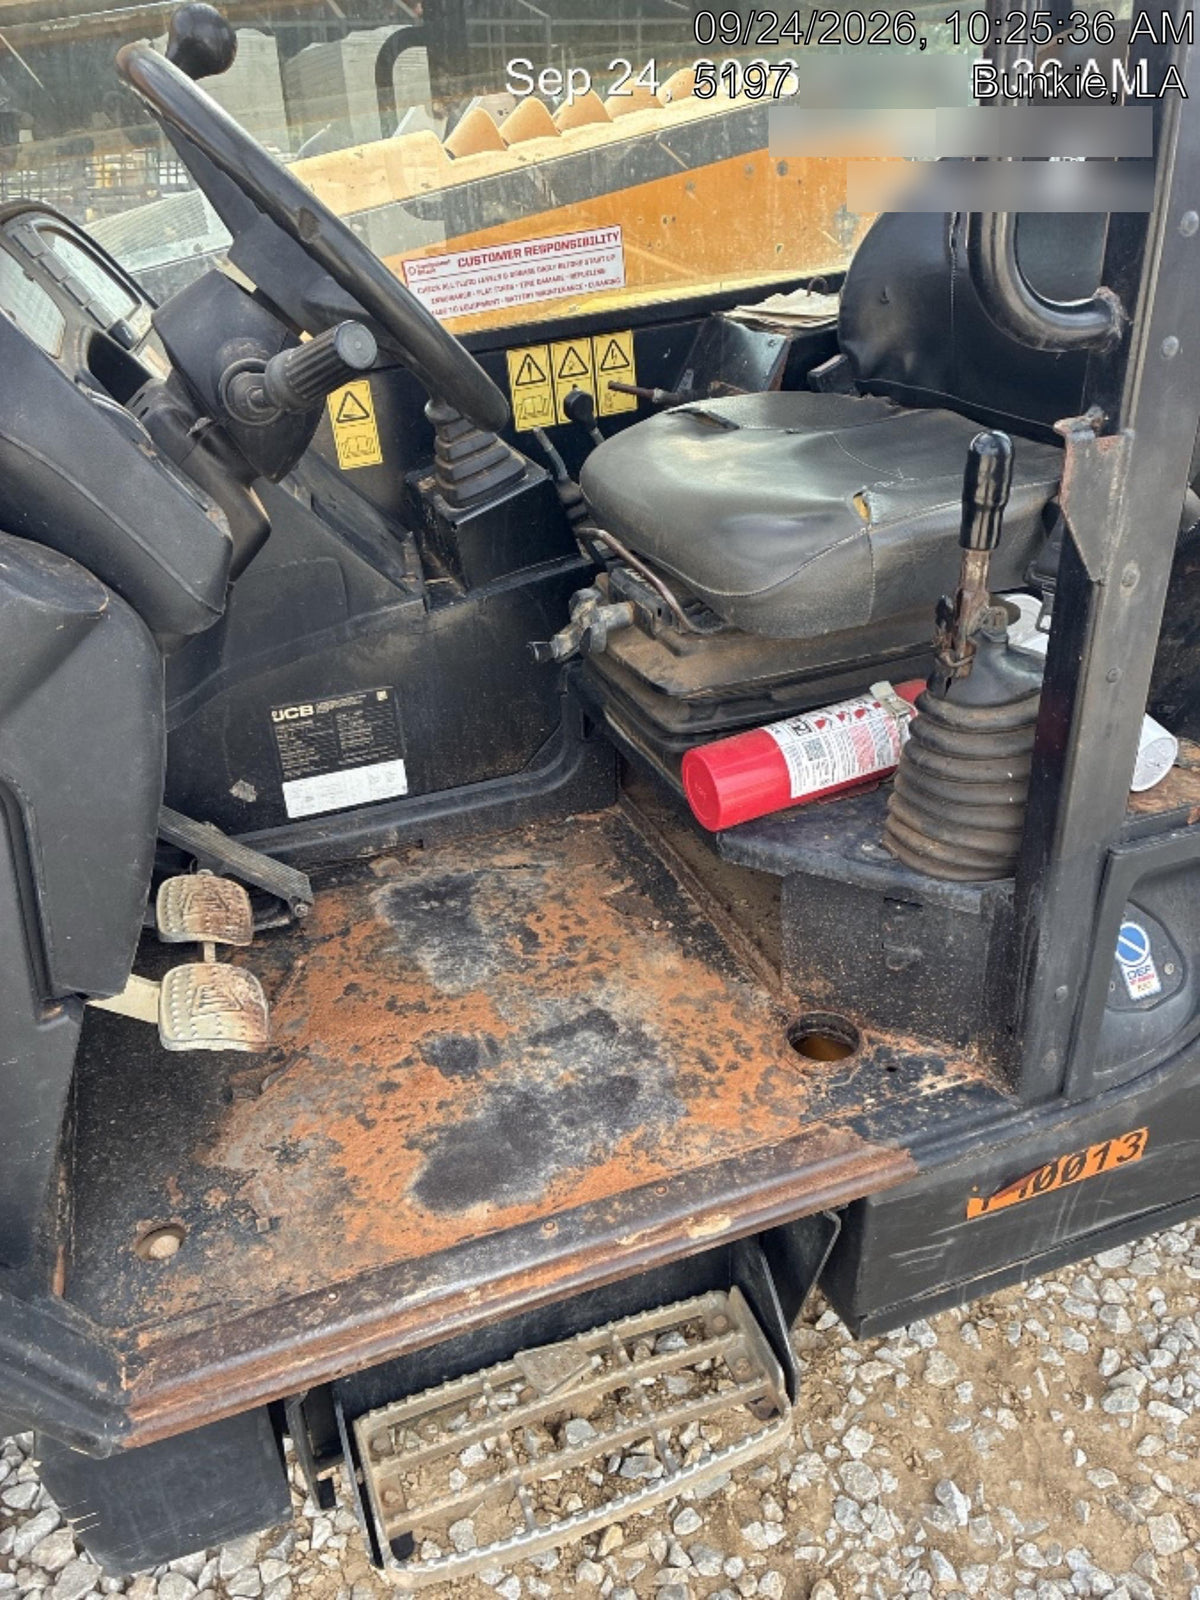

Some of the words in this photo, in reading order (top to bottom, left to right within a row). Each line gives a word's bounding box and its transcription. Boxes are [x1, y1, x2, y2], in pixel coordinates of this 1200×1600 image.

[458, 247, 522, 268] CUSTOMER
[524, 231, 620, 256] RESPONSIBILITY
[271, 705, 315, 722] JCB
